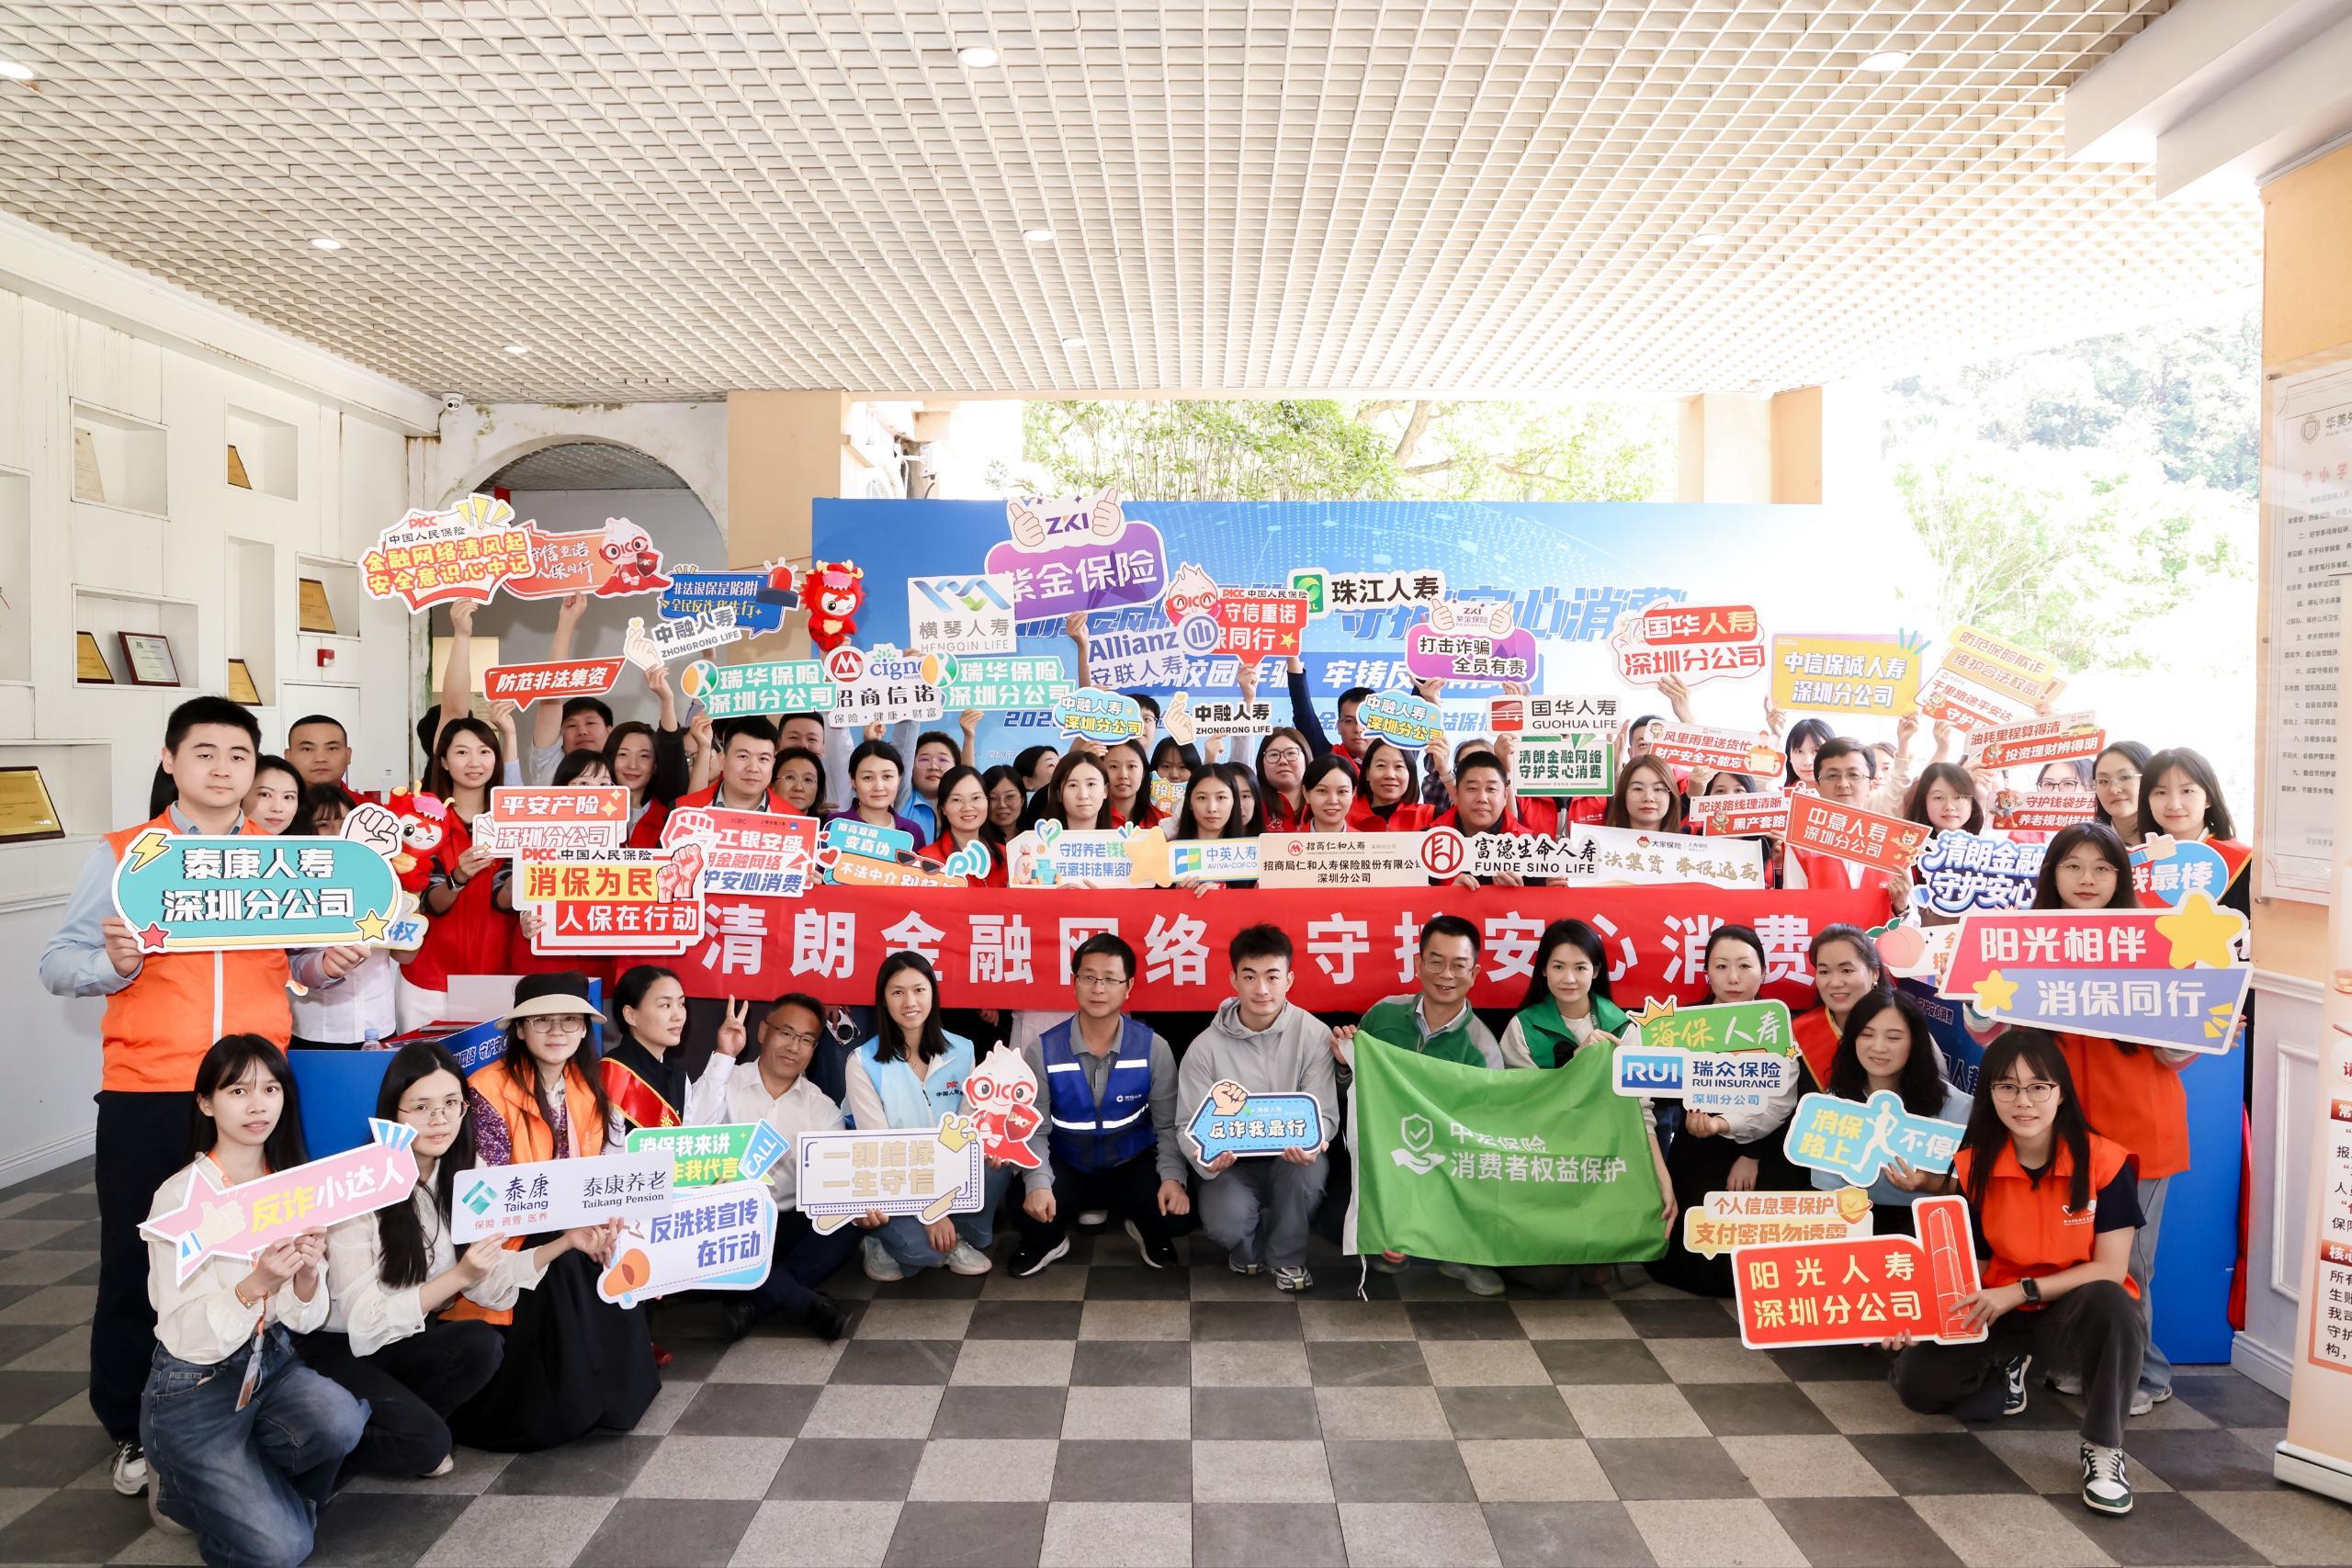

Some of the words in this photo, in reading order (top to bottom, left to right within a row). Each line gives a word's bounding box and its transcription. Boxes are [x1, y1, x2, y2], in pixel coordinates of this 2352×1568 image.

[409, 515, 437, 529] PICC
[1046, 513, 1090, 536] ZKI
[389, 526, 465, 545] 中国人民保险
[364, 532, 526, 574] 金融网络清风起
[368, 553, 532, 595] 安全意识心中记
[673, 581, 758, 596] 非法退保是陷阱
[1222, 589, 1245, 598] PICC
[1248, 589, 1308, 599] 中国人民保险
[1332, 576, 1439, 604] 珠江人寿
[1226, 603, 1297, 624] 守信重诺
[1645, 611, 1756, 639] 国华人寿
[655, 608, 733, 644] 中融人寿
[919, 618, 1009, 640] 横琴人寿
[662, 636, 718, 658] ZHONGRONG
[720, 630, 740, 642] LIFE
[985, 639, 1009, 650] LIFE
[1089, 630, 1179, 662] Allianz
[1419, 637, 1491, 656] 打击诈骗
[1959, 632, 2046, 674] 防范保险欺诈
[870, 659, 922, 680] cign
[961, 661, 1057, 682] 瑞华保险
[1091, 655, 1183, 686] 安联人寿
[1455, 658, 1525, 677] 全员有责
[1624, 645, 1765, 675] 深圳分公司
[1785, 650, 1907, 681] 中信保诚人寿
[496, 667, 608, 694] 防范非法集资
[720, 664, 820, 690] 瑞华保险
[709, 686, 832, 714] 深圳分公司
[949, 684, 1070, 706] 深圳分公司
[1060, 695, 1124, 715] 中融人寿
[1792, 679, 1894, 708] 深圳分公司
[1195, 703, 1271, 722] 中融人寿
[1365, 695, 1427, 721] 中融人寿
[1532, 699, 1617, 716] 国华人寿
[1004, 711, 1057, 728] 202
[1065, 714, 1143, 736] 深圳分公司
[1195, 725, 1250, 735] ZHONGRONG
[1252, 725, 1271, 734] LIFE
[1366, 715, 1443, 741] 深圳分公司
[1532, 720, 1589, 729] GUOHUA
[1593, 719, 1617, 728] LIFE
[1663, 731, 1753, 752] 风里雨里送货忙
[1971, 721, 2060, 746] 油耗里程算得清
[1519, 749, 1602, 764] 清朗金融网络
[1656, 746, 1743, 769] 财产安全不能忘
[2005, 738, 2098, 763] 投资理财辨得明
[1519, 765, 1602, 779] 守护安心消费
[501, 795, 599, 815] 平安产险
[1698, 796, 1781, 814] 配送路线理清晰
[1733, 814, 1786, 831] 黑产套路
[1807, 807, 1888, 843] 中意人寿
[496, 826, 610, 848] 深圳分公司
[720, 829, 804, 852] 工银安盛
[1306, 840, 1365, 851] 招商仁和人寿
[1804, 825, 1883, 859] 深圳分公司
[522, 849, 557, 860] PICC
[560, 849, 653, 861] 中国人民保险
[1206, 846, 1257, 861] 中英人寿
[1475, 837, 1597, 863] 富德生命人寿
[182, 848, 334, 880] 泰康人寿
[1475, 863, 1521, 873] FUNDE
[1527, 863, 1560, 873] SINO
[1566, 863, 1595, 874] LIFE
[1598, 851, 1665, 874] 法集资
[529, 867, 651, 897] 消保为民
[1317, 873, 1371, 884] 深圳分公司
[162, 888, 356, 923] 深圳分公司
[558, 905, 696, 931] 人保在行动
[1981, 926, 2147, 963] 阳光相伴
[2037, 980, 2206, 1018] 消保同行
[1650, 1010, 1781, 1048] 海保人寿
[1627, 1062, 1678, 1083] RUI
[1692, 1061, 1781, 1078] 瑞众保险
[1692, 1079, 1713, 1088] RUI
[1715, 1078, 1781, 1089] INSURANCE
[1692, 1093, 1760, 1106] 深圳分公司
[1208, 1118, 1307, 1140] 反诈我最行
[1811, 1108, 1864, 1140] 消保
[639, 1133, 730, 1156] 消保我来讲
[745, 1135, 777, 1177] CALL
[823, 1140, 935, 1168] 一朝结缘
[1799, 1134, 1851, 1166] 路上
[1450, 1151, 1627, 1184] 消费者权益保护
[503, 1173, 548, 1201] 泰康
[582, 1170, 666, 1198] 泰康养老
[823, 1168, 934, 1198] 一生守信
[251, 1156, 404, 1235] 反诈小达人
[503, 1200, 548, 1213] Taikang
[582, 1195, 622, 1210] Taikang
[626, 1192, 664, 1205] Pension
[1713, 1196, 1835, 1216] 个人信息要保护
[474, 1219, 495, 1231] 保险
[527, 1213, 548, 1224] 医养
[650, 1198, 759, 1244] 反洗钱宣传
[697, 1231, 761, 1269] 在行动
[1749, 1251, 1915, 1290] 阳光人寿
[1753, 1291, 1922, 1329] 深圳分公司
